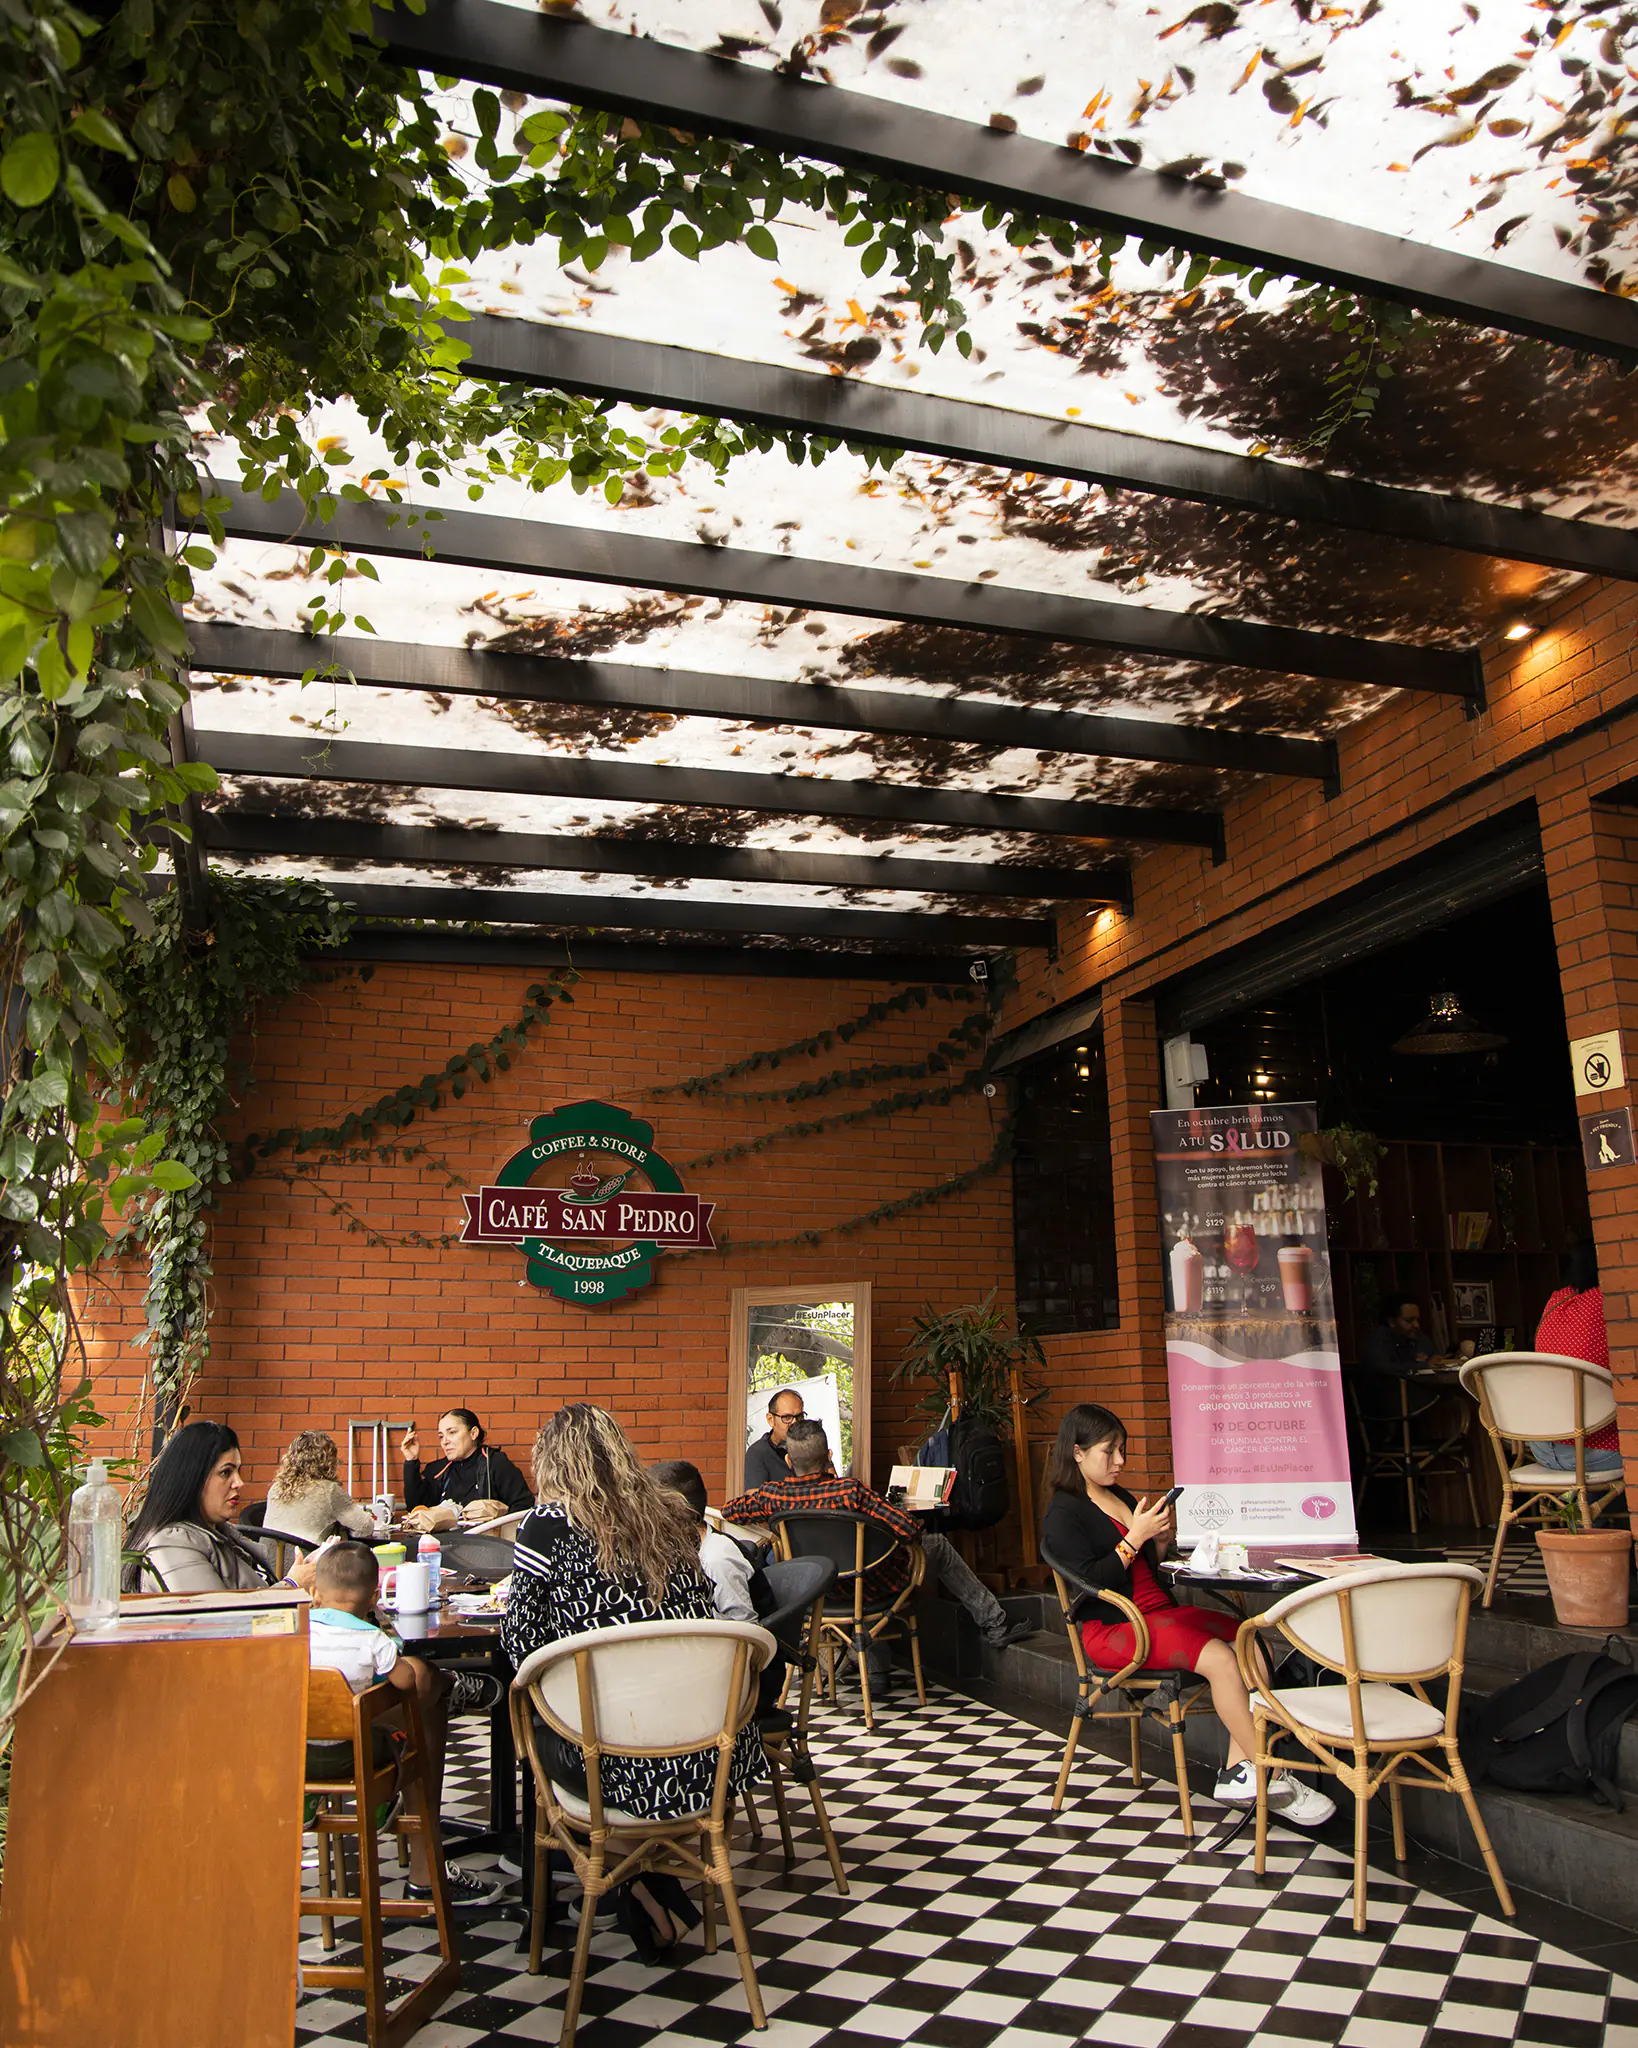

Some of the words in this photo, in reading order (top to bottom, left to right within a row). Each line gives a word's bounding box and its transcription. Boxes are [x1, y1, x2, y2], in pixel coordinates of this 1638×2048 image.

[1178, 1119, 1190, 1128] En
[1192, 1117, 1230, 1127] octubre
[1232, 1114, 1284, 1124] brindamos
[1179, 1138, 1188, 1147] A
[1189, 1136, 1205, 1147] TU
[531, 1135, 586, 1160] COFFEE
[588, 1135, 599, 1148] &
[601, 1136, 648, 1164] STORE
[1206, 1166, 1228, 1175] apoyo,
[1236, 1164, 1263, 1172] daremos
[1263, 1162, 1283, 1170] fuerza
[1187, 1174, 1200, 1182] más
[1201, 1174, 1226, 1183] mujeres
[1227, 1173, 1240, 1181] para
[1241, 1171, 1261, 1180] seguir
[1270, 1169, 1288, 1177] lucha
[1225, 1179, 1247, 1187] cáncer
[1247, 1178, 1256, 1186] de
[488, 1198, 549, 1230] CAFÉ
[561, 1208, 607, 1231] SAN
[617, 1203, 695, 1234] PEDRO
[1205, 1218, 1225, 1228] $129
[536, 1243, 642, 1271] TLAQUEPAQUE
[573, 1280, 605, 1294] 1998
[1206, 1286, 1225, 1295] $119
[1260, 1284, 1276, 1293] $69
[796, 1310, 850, 1319] #EsUnPlacer
[1181, 1382, 1226, 1392] Donaremos
[1239, 1380, 1282, 1391] porcentaje
[1283, 1380, 1294, 1389] de
[1296, 1379, 1304, 1388] la
[1305, 1379, 1328, 1388] venta
[1209, 1392, 1220, 1401] de
[1244, 1392, 1250, 1400] 3
[1252, 1390, 1293, 1401] productos
[1198, 1402, 1231, 1411] GRUPO
[1232, 1400, 1290, 1411] VOLUNTARIO
[1291, 1400, 1313, 1409] VIVE
[1212, 1422, 1225, 1432] 19
[1228, 1421, 1244, 1432] DE
[1247, 1420, 1306, 1431] OCTUBRE
[1226, 1437, 1262, 1446] MUNDIAL
[1263, 1436, 1298, 1445] CONTRA
[1299, 1435, 1309, 1444] EL
[1259, 1445, 1270, 1453] DE
[1271, 1445, 1298, 1453] MAMA
[1208, 1465, 1251, 1475] Apoyar...
[1253, 1463, 1314, 1473] #EsUnPlacer
[1188, 1508, 1205, 1516] SAN
[1206, 1508, 1234, 1516] PEDRO
